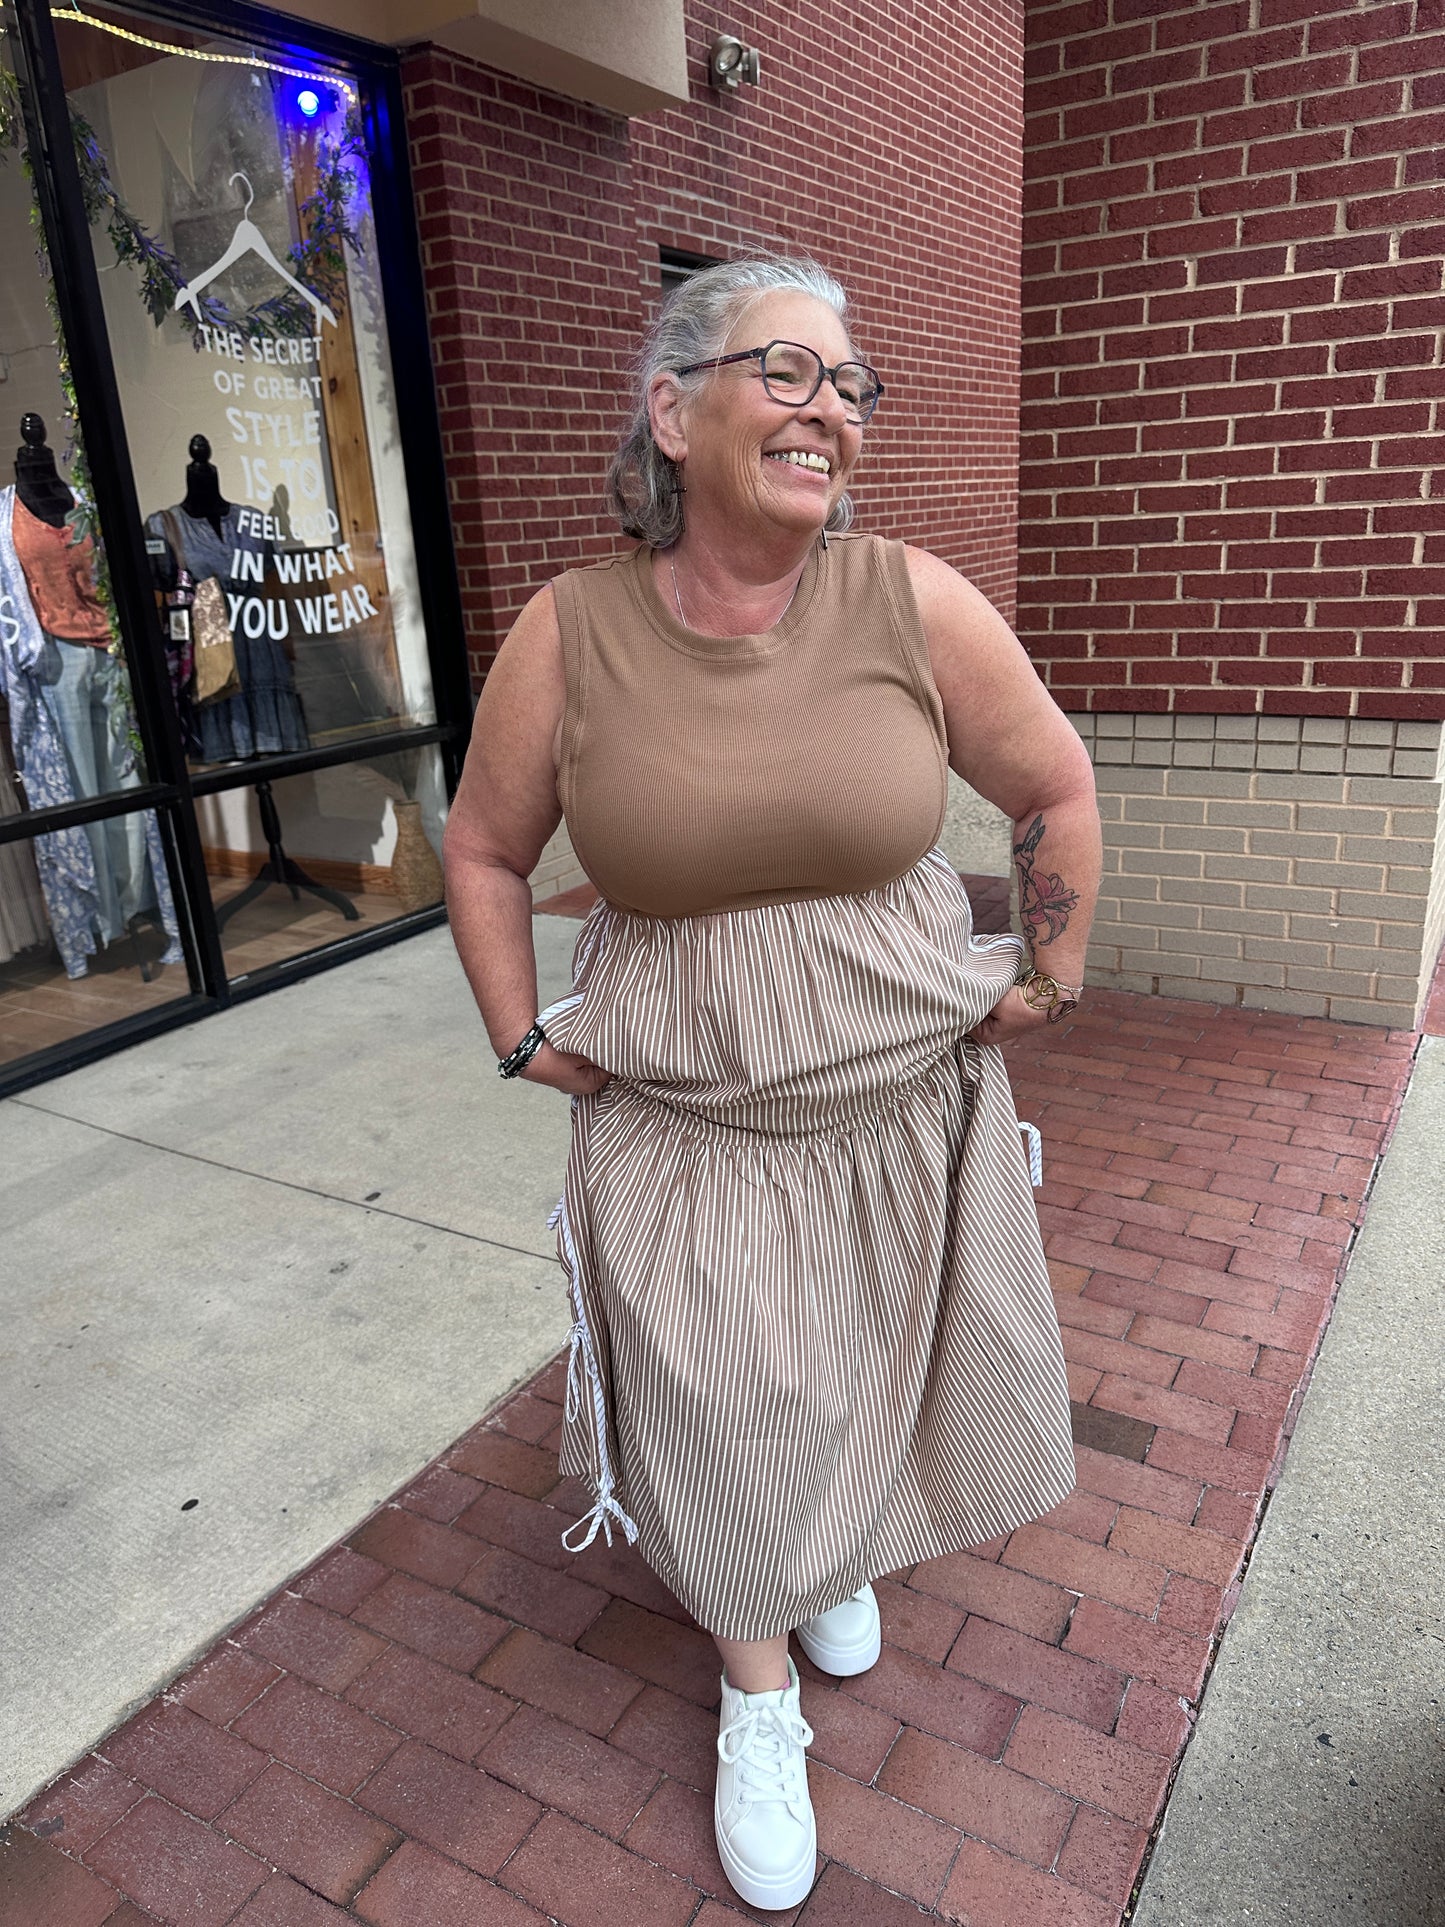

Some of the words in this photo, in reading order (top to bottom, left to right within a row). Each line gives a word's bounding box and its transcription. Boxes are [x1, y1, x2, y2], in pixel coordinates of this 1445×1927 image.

[198, 323, 246, 361] THE
[249, 336, 323, 365] SECRET
[213, 370, 245, 396] OF
[254, 375, 322, 400] GREAT
[226, 406, 321, 447] STYLE
[240, 455, 273, 501] IS
[279, 457, 322, 502] TO
[237, 509, 286, 541] FEEL
[289, 508, 339, 541] GOOD
[230, 548, 264, 583] IN
[273, 543, 355, 584] WHAT
[226, 592, 289, 641] YOU
[295, 584, 379, 635] WEAR
